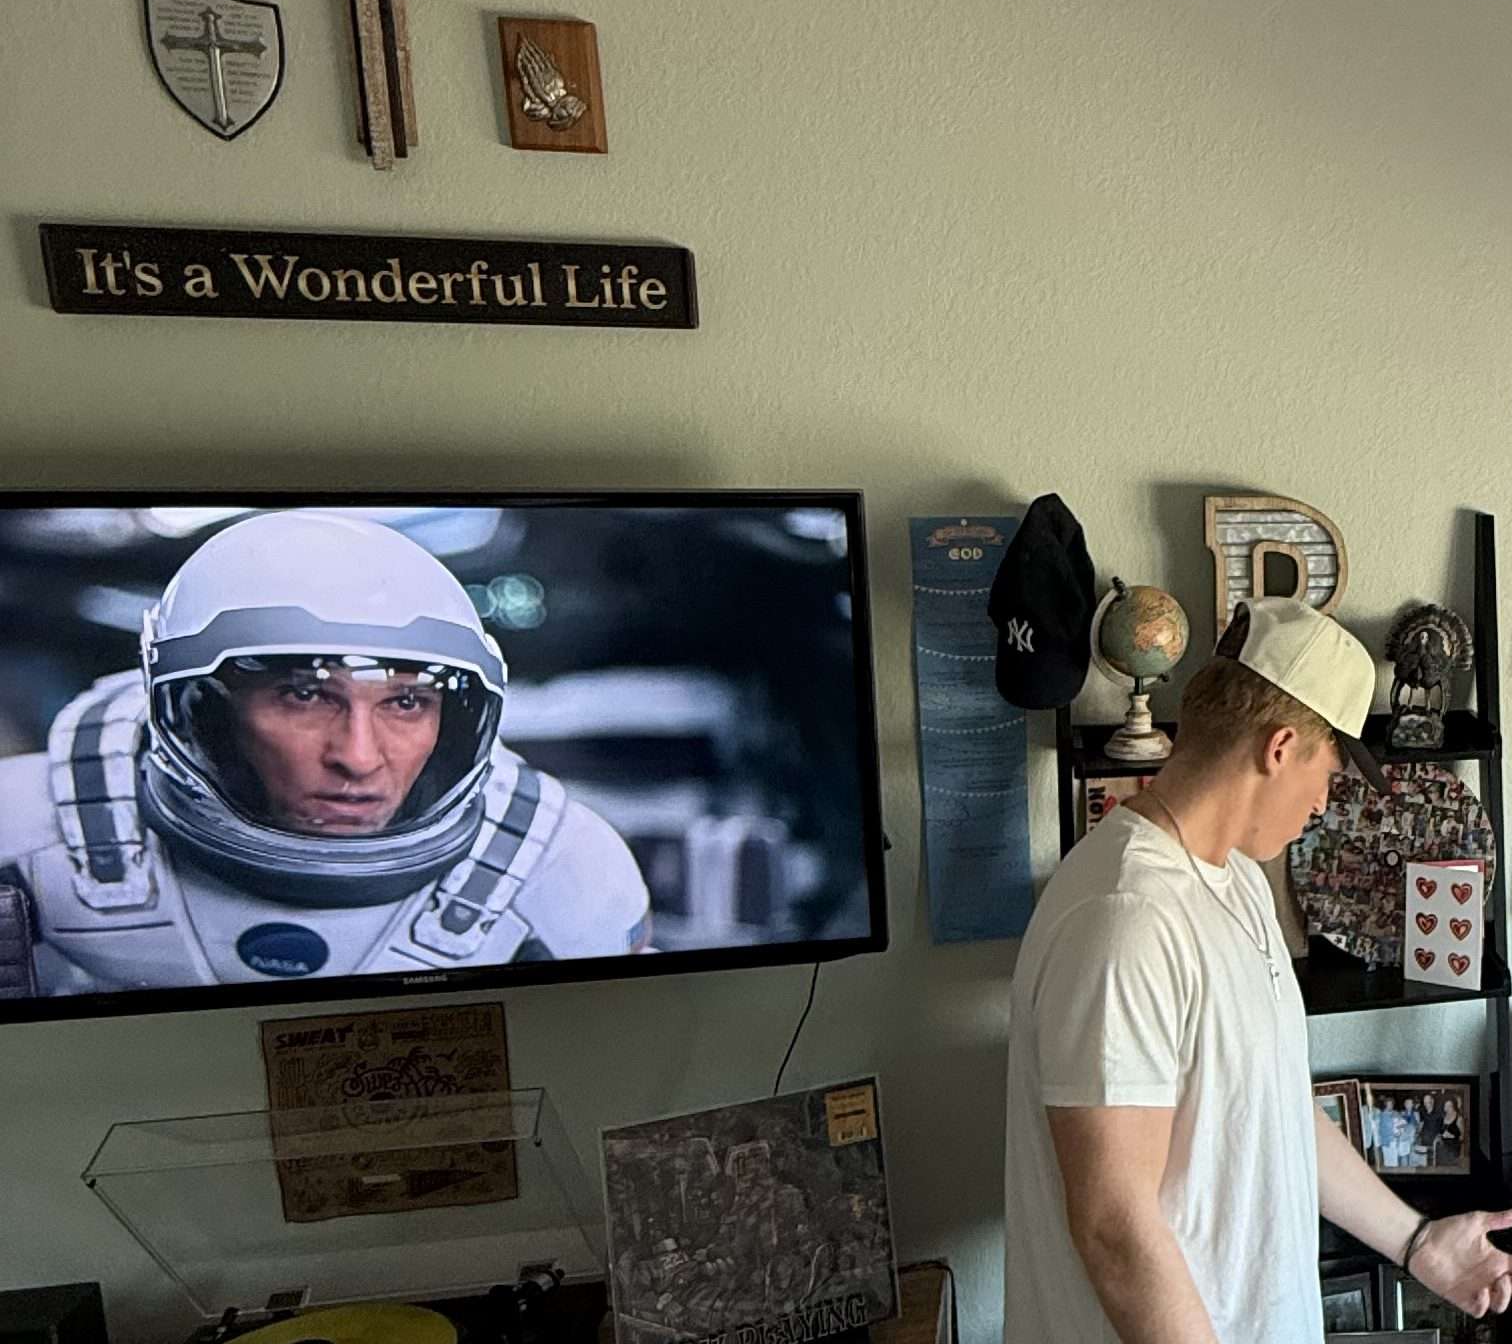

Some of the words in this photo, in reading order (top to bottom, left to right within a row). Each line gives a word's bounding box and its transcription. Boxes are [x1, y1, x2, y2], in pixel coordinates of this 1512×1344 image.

[81, 248, 163, 298] It's
[184, 262, 218, 298] a
[230, 252, 548, 308] Wonderful
[565, 264, 669, 311] Life
[249, 954, 310, 974] NASA
[402, 974, 448, 986] SAMSUNG
[272, 1024, 353, 1050] SWEAT
